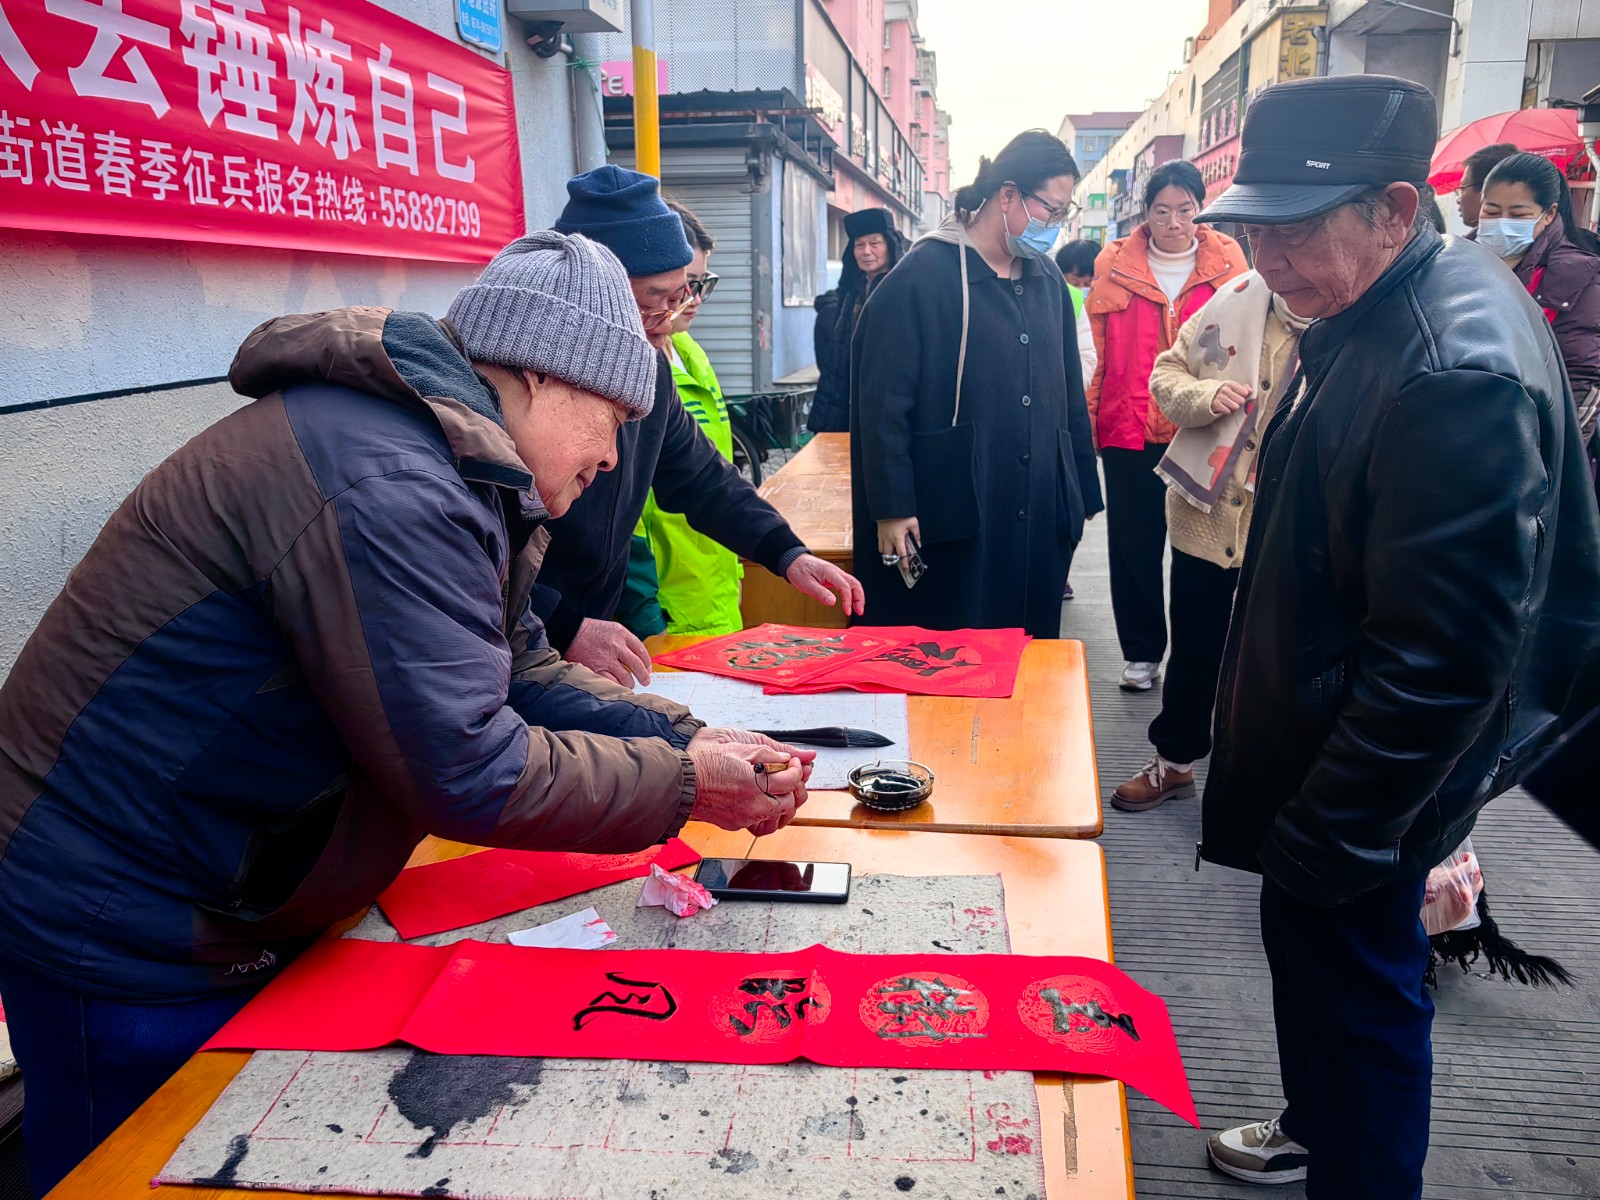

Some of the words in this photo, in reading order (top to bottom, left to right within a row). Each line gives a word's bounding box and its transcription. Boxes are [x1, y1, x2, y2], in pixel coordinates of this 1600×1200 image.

[0, 0, 477, 183] 去锤炼自己
[1305, 159, 1332, 170] SPORT
